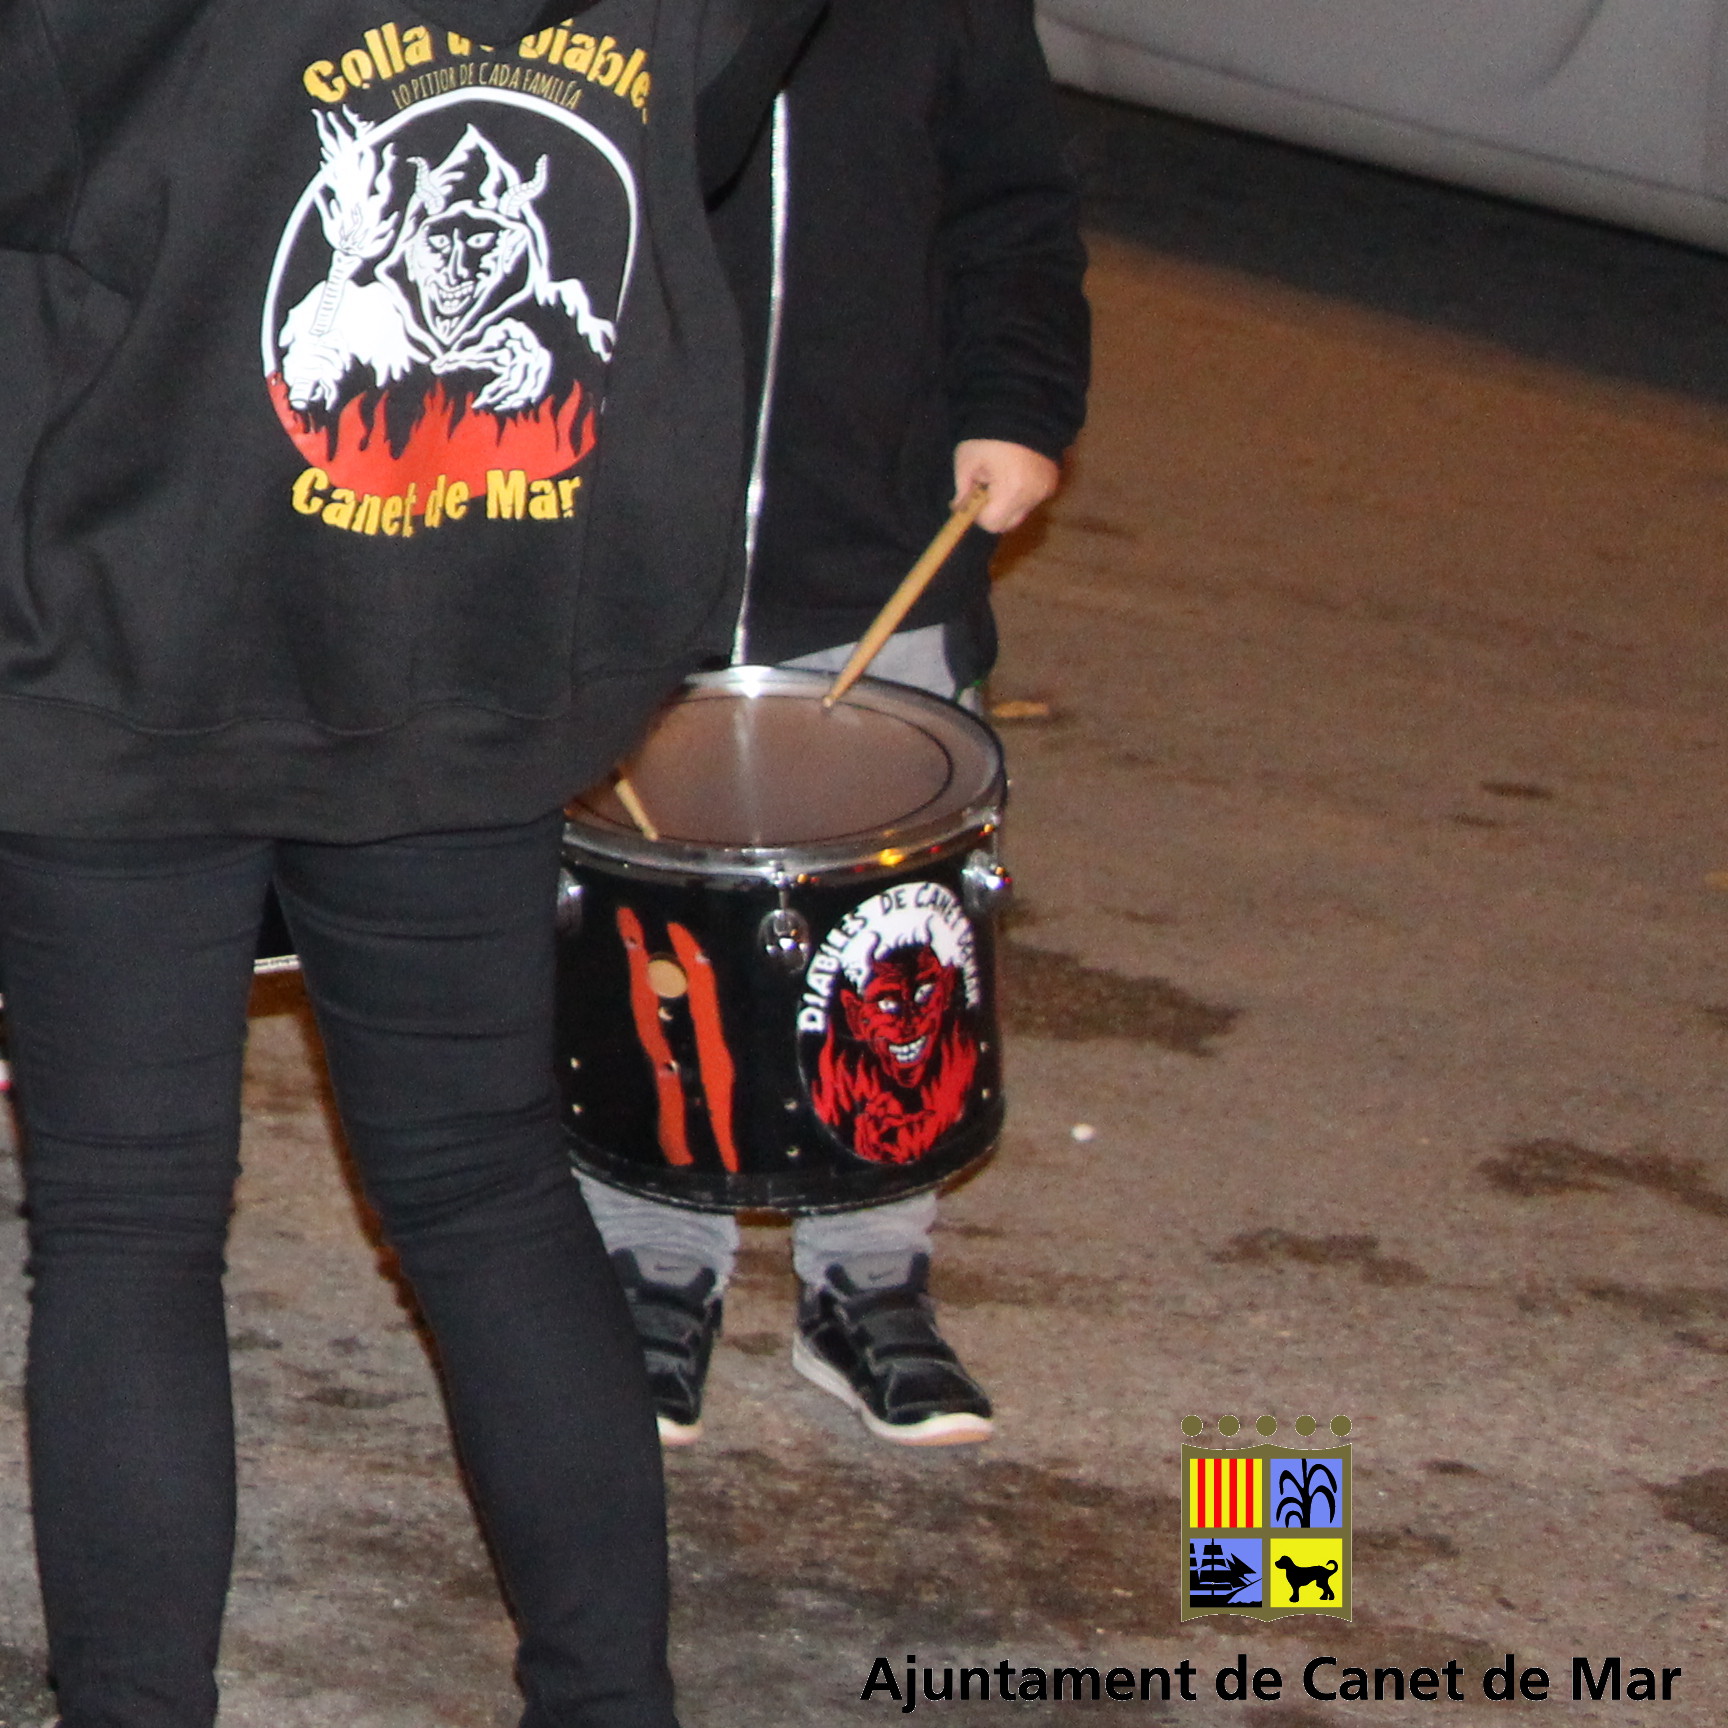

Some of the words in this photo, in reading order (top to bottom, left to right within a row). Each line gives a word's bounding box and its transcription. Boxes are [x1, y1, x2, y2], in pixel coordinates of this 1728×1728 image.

[303, 21, 433, 103] Colla
[391, 84, 411, 110] LO
[460, 62, 475, 86] DE
[479, 62, 520, 89] CADA
[291, 466, 418, 539] Canet
[425, 474, 467, 528] de
[486, 468, 585, 522] Mar
[797, 908, 868, 1033] DIABLES
[879, 888, 908, 915] DE
